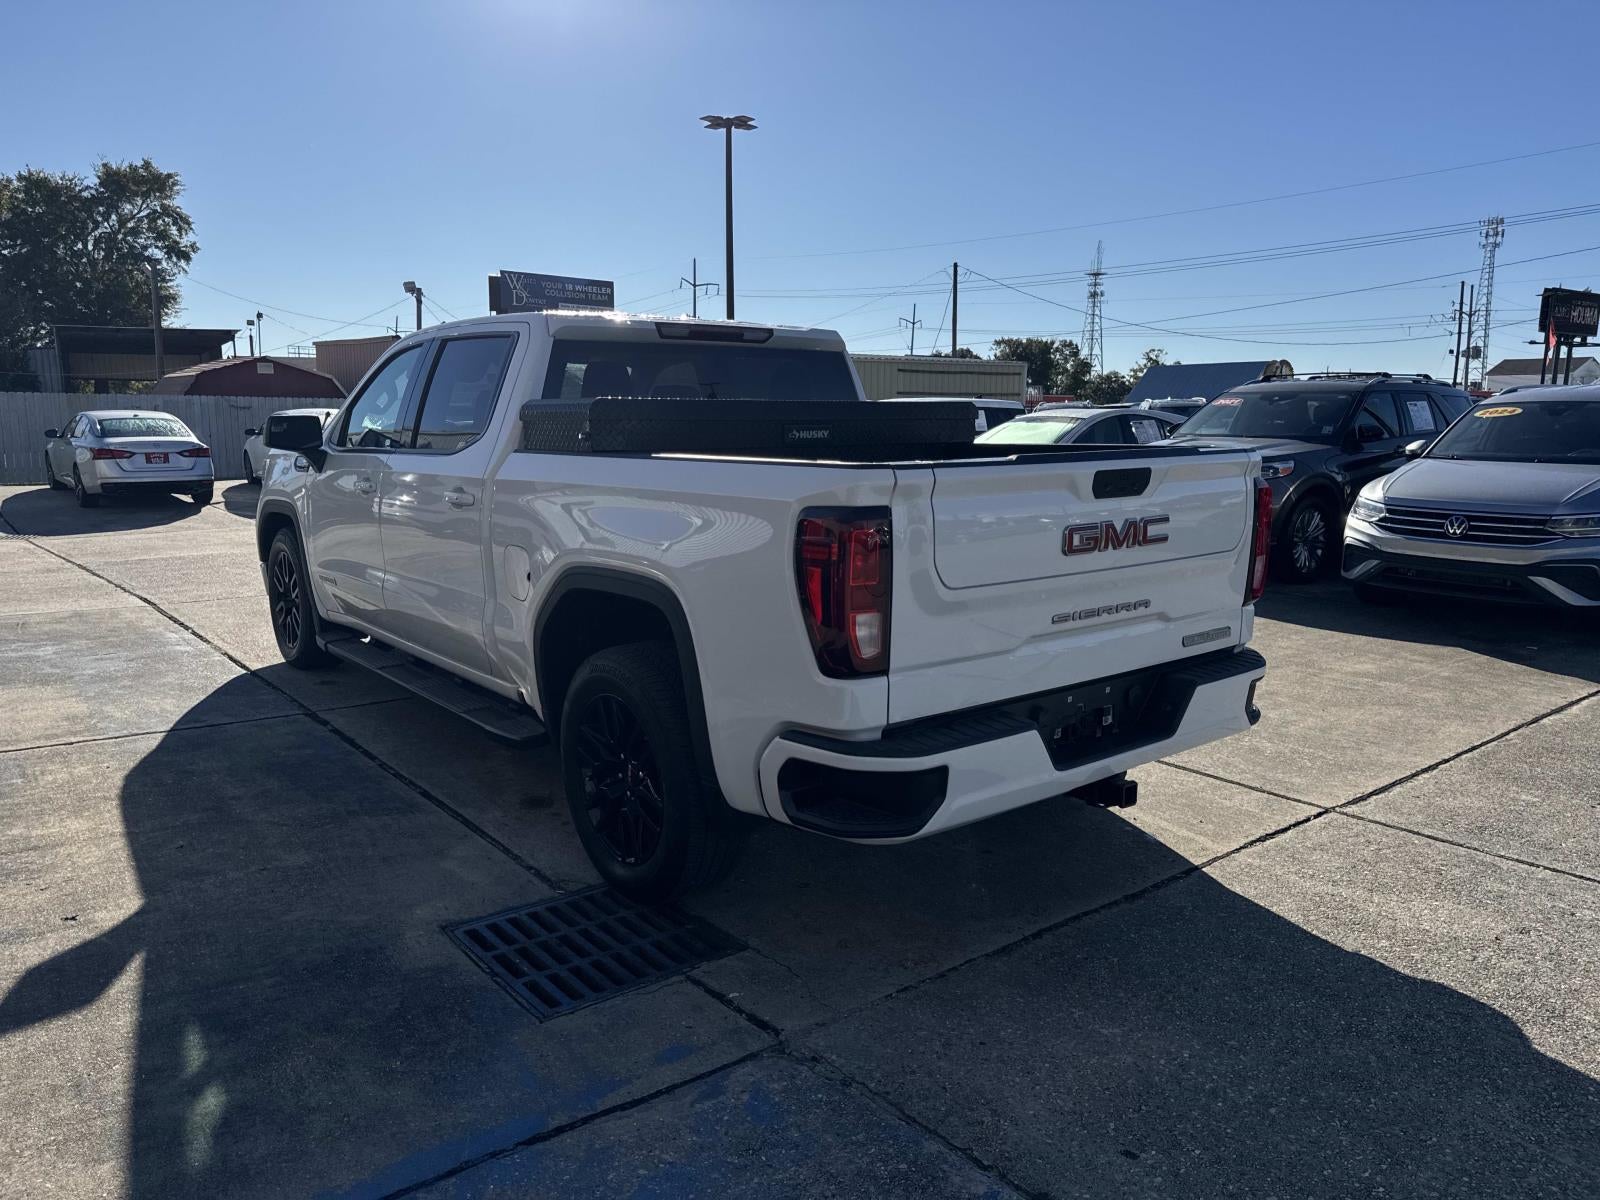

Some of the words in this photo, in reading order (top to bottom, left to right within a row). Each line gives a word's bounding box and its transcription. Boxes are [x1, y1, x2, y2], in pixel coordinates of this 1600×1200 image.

[541, 281, 563, 289] YOUR
[564, 283, 573, 291] 18
[575, 284, 612, 295] WHEELER
[545, 289, 586, 300] COLLISION
[588, 293, 609, 301] TEAM
[1480, 408, 1518, 416] 2024
[800, 430, 830, 439] HUSKY
[1062, 514, 1170, 556] GMC
[1052, 598, 1152, 625] SIERRA
